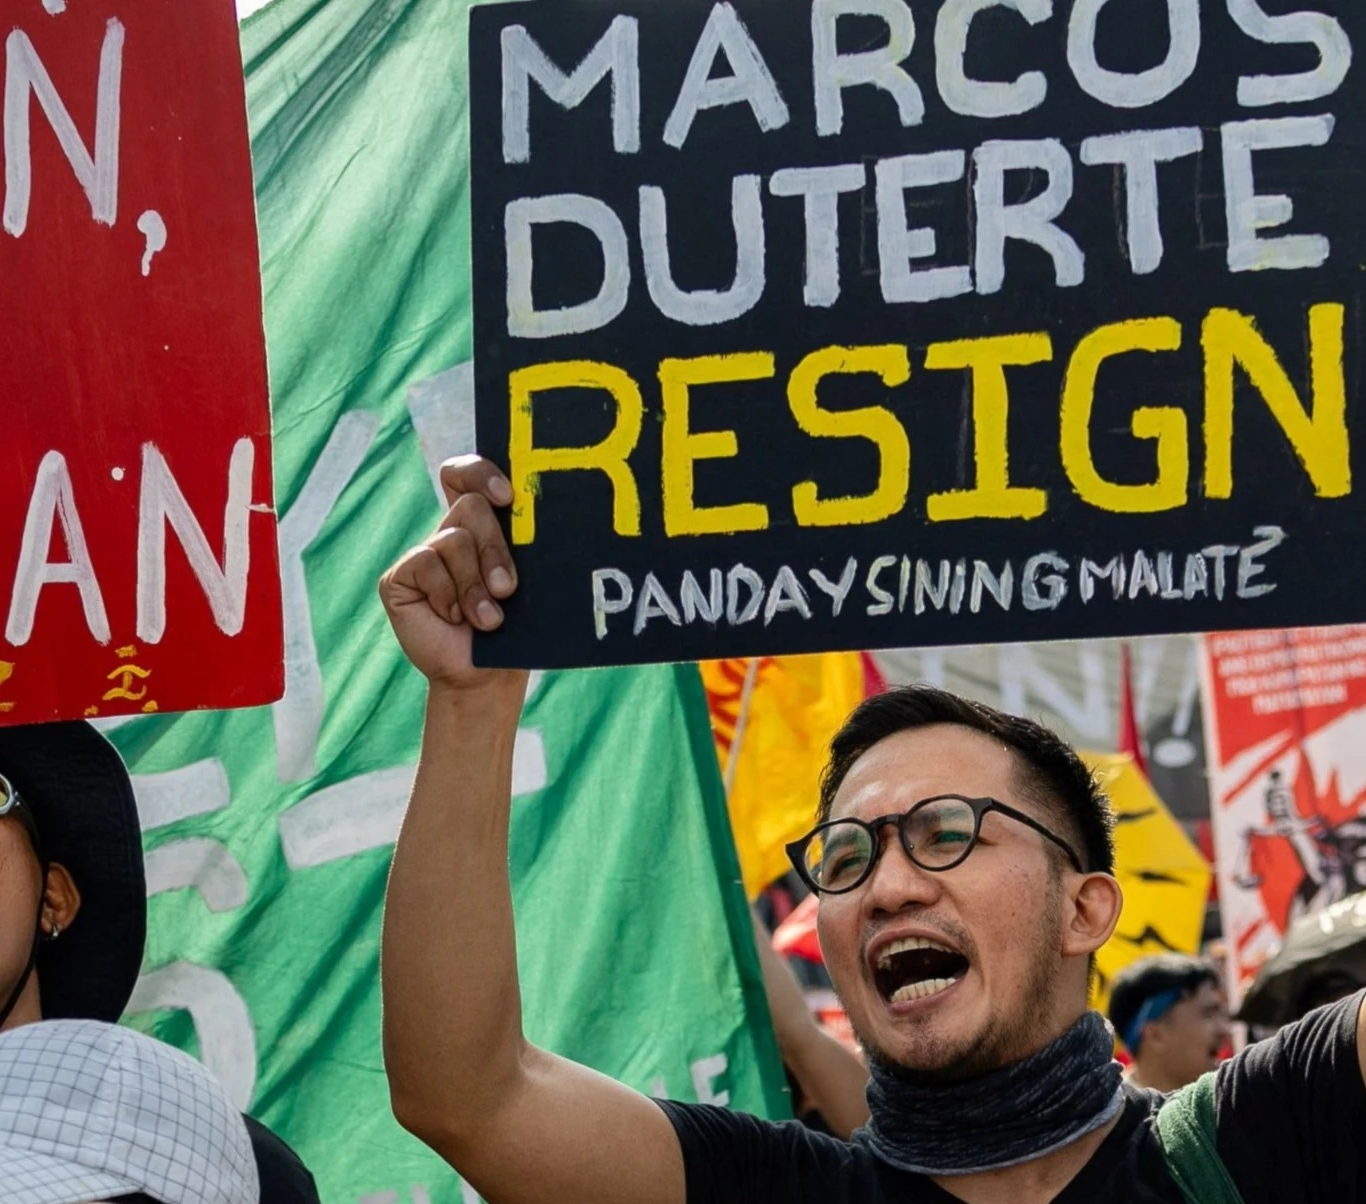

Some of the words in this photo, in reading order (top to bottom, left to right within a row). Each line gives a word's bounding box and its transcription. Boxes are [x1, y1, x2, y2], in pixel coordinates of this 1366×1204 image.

[499, 0, 1353, 164] MARCOS
[505, 113, 1336, 339] DUTERTE
[509, 302, 1352, 546] RESIGN
